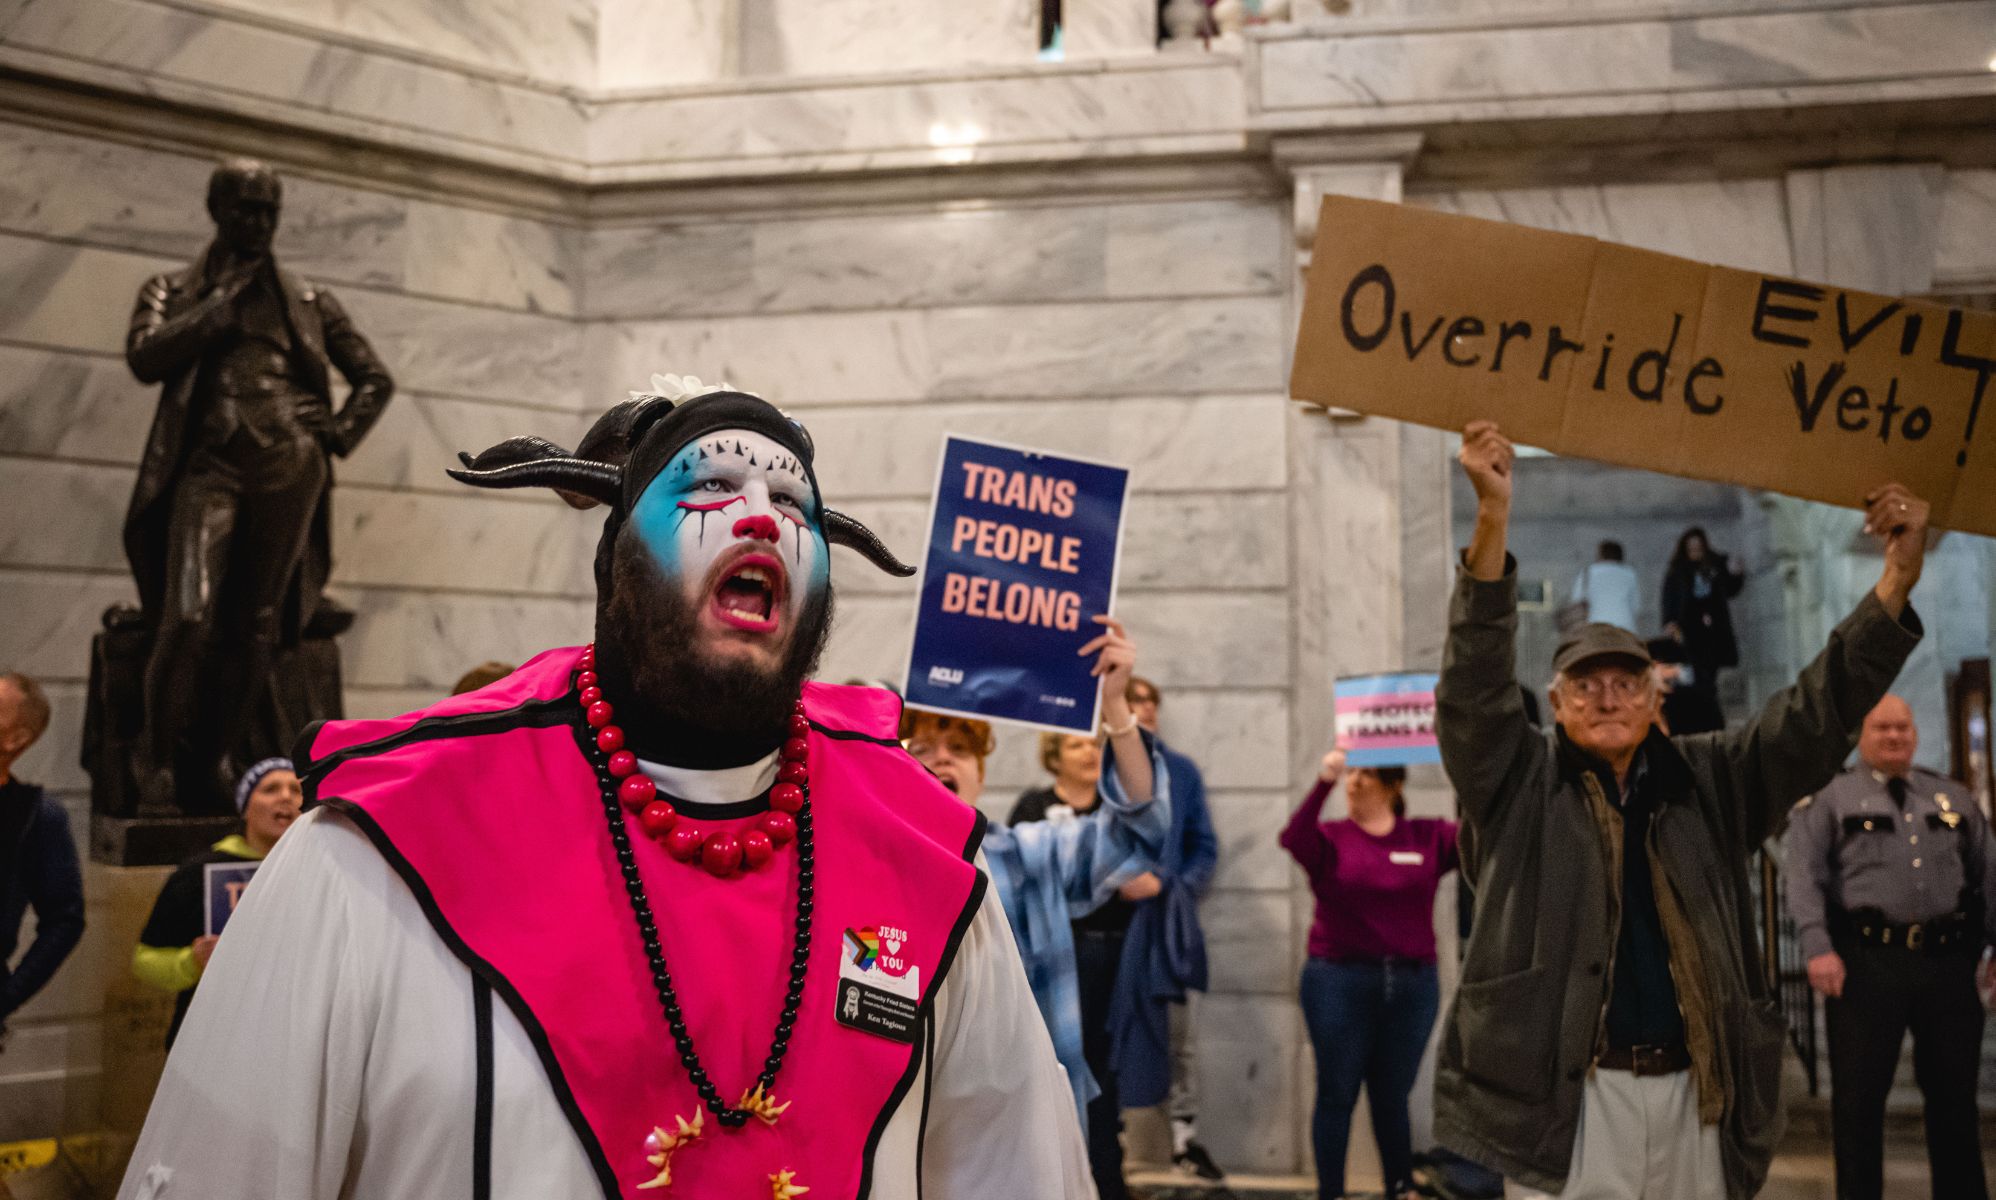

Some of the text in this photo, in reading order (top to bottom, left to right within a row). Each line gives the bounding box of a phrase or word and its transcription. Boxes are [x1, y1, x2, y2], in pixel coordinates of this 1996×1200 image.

[1752, 279, 1996, 373] EVIL
[1340, 264, 1724, 414] Override
[962, 462, 1077, 519] TRANS
[951, 516, 1082, 574] PEOPLE
[941, 572, 1082, 631] BELONG
[1360, 701, 1435, 718] PROTEC
[1348, 723, 1411, 738] TRANS
[878, 926, 908, 942] JESUS
[881, 955, 904, 970] YOU
[864, 991, 886, 1004] Kentucky
[886, 997, 899, 1007] Fried
[867, 1013, 906, 1031] Ken Tagious
